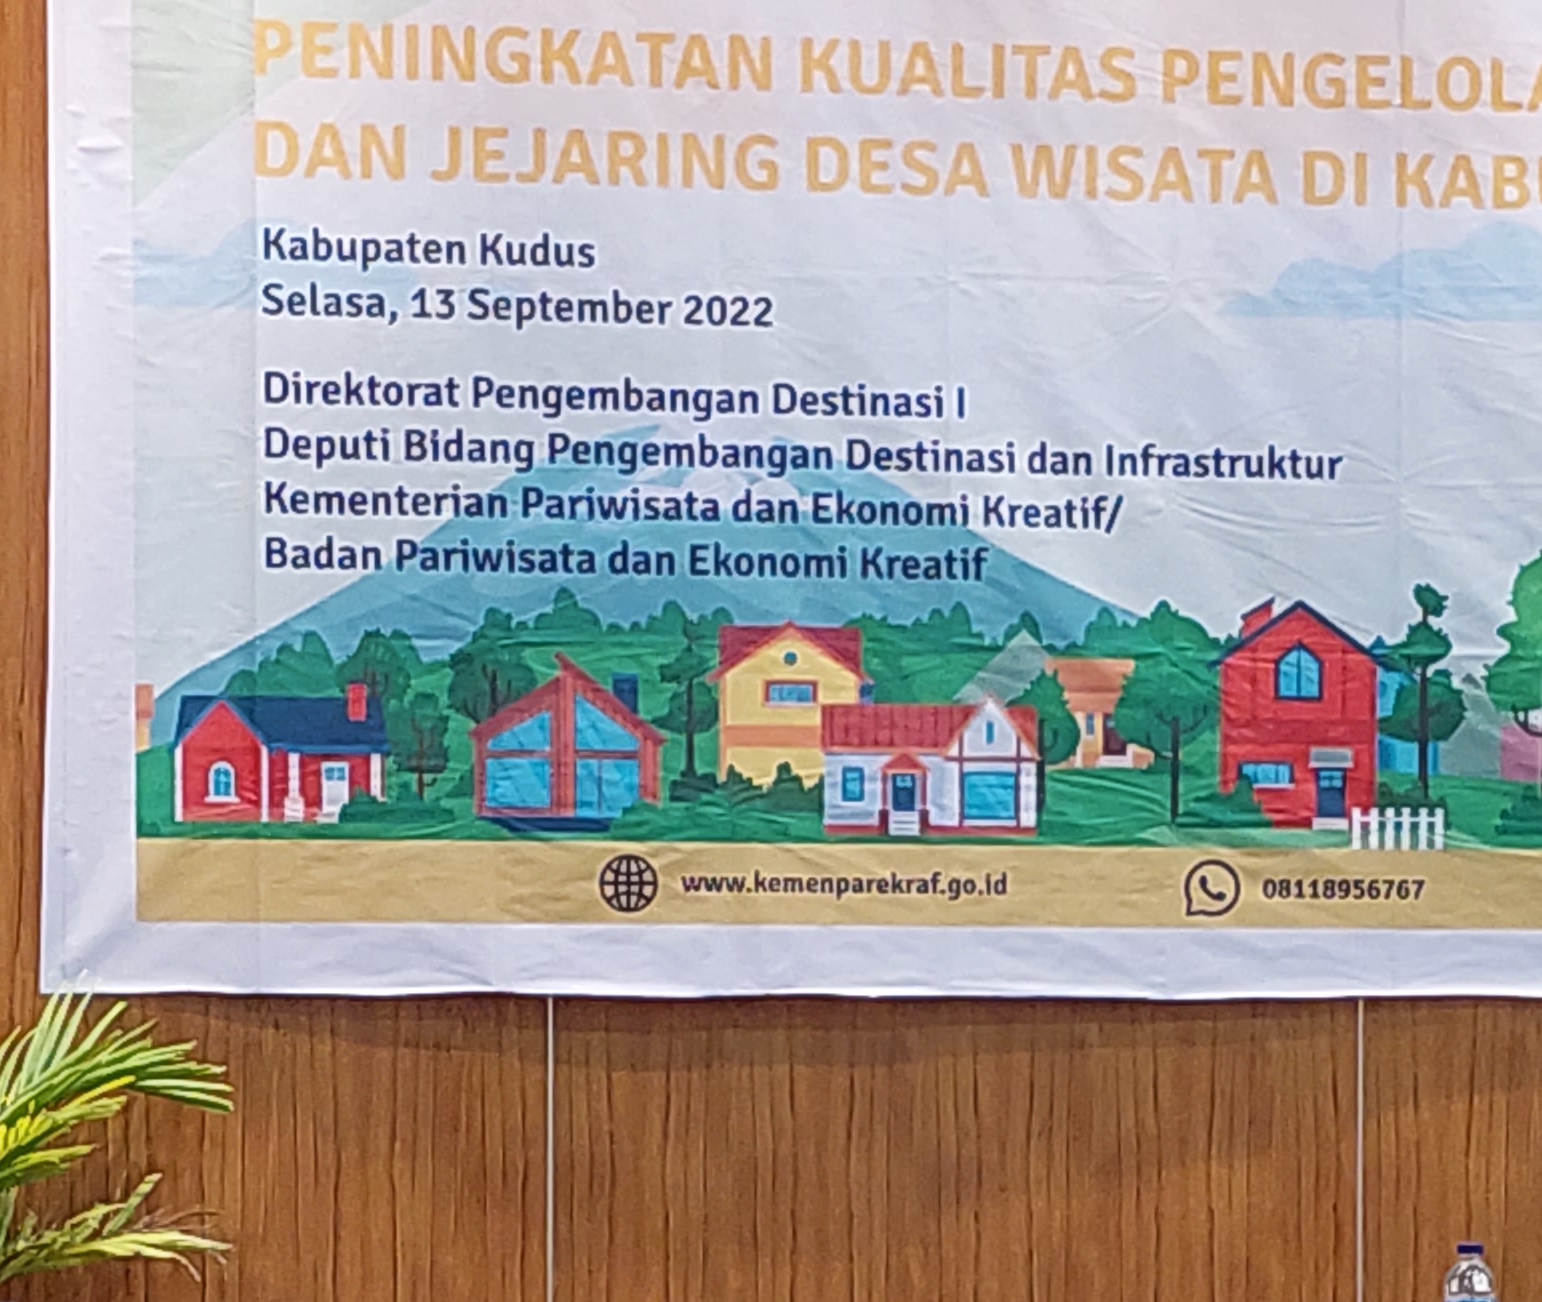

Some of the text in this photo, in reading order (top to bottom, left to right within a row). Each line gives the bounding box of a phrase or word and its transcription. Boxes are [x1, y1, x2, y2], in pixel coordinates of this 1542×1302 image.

[254, 18, 772, 91] PENINGKATAN
[800, 38, 1137, 103] KUALITAS
[255, 120, 405, 181] DAN
[431, 125, 779, 191] JEJARING
[806, 137, 988, 198] DESA
[1012, 144, 1275, 204] WISATA
[1303, 150, 1367, 206] DI
[263, 229, 595, 270] Kabupaten Kudus
[262, 283, 773, 330] Selasa, 13 September 2022
[264, 371, 965, 422] Direktorat Pengembangan Destinasi I
[264, 427, 1342, 480] Deputi Bidang Pengembangan Destinasi dan Infrastruktur
[265, 483, 1122, 533] Kementerian Pariwisata dan Ekonomi Kreatif/
[265, 537, 990, 581] Badan Pariwisata dan Ekonomi Kreatif
[681, 870, 1008, 900] www.kemenparekraf.go.id
[1262, 878, 1426, 900] 08118956767
